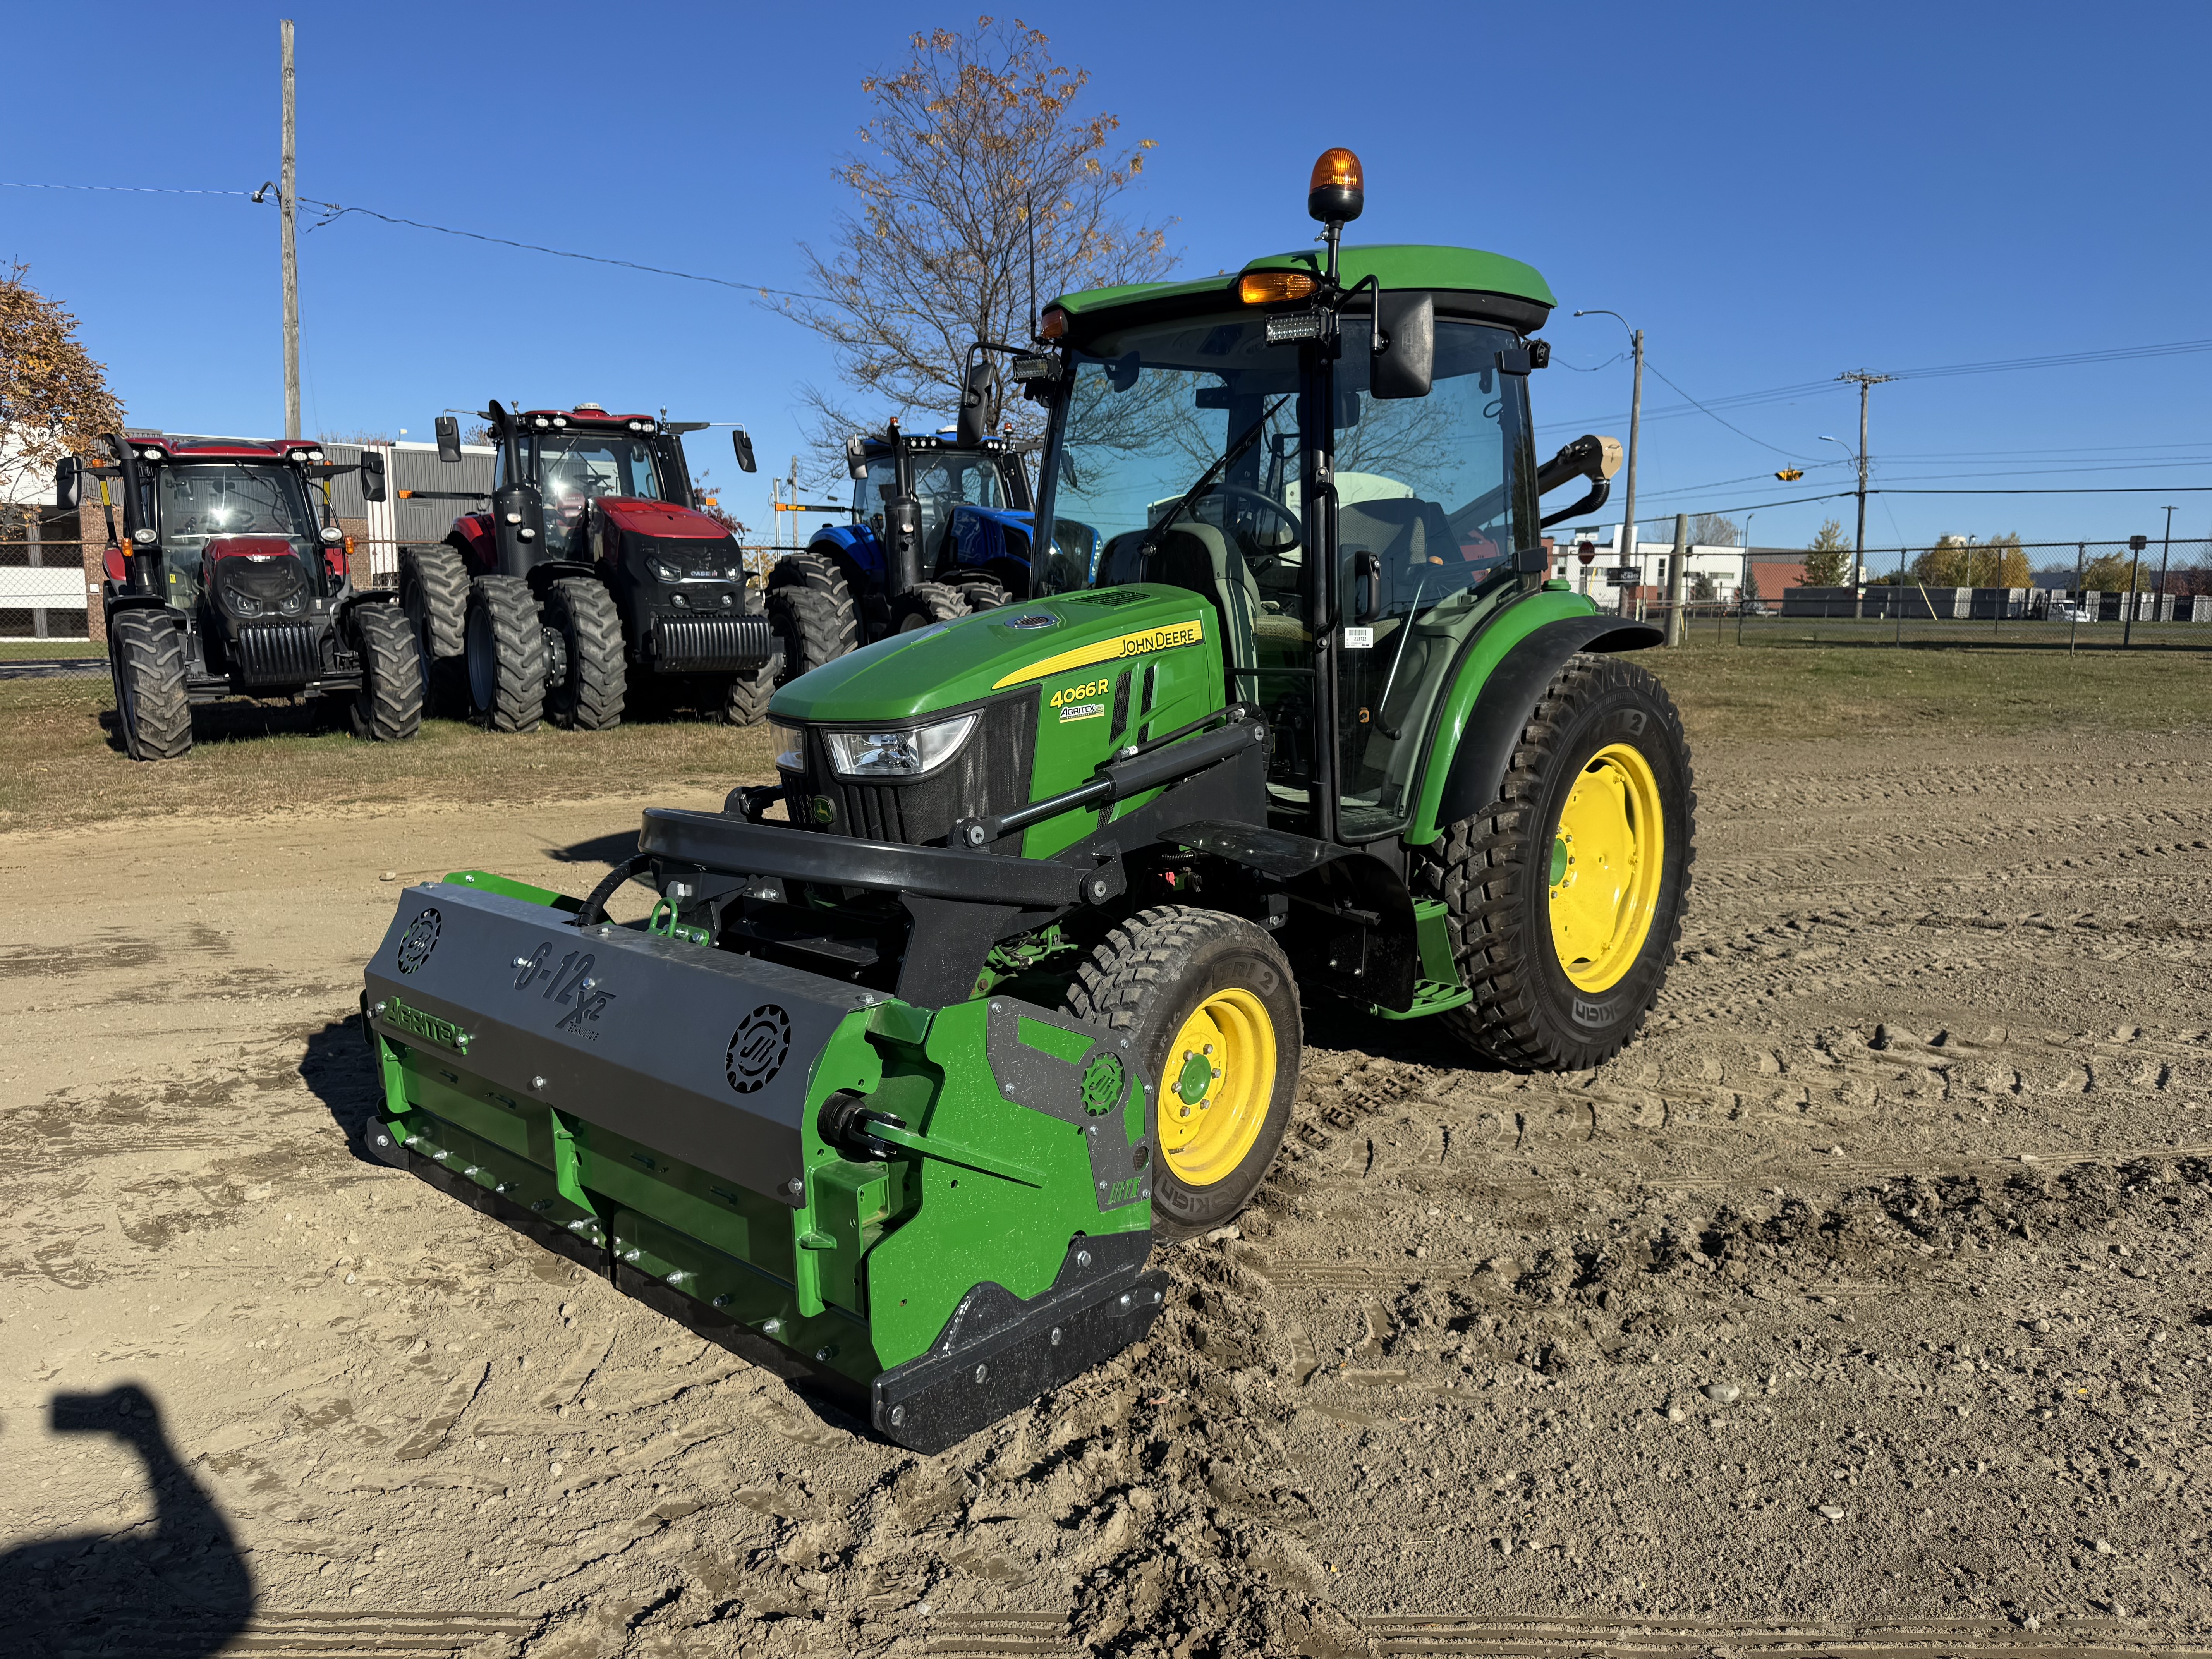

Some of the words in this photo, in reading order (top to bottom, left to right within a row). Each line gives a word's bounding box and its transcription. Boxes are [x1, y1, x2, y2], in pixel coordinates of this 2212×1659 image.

[1119, 636, 1154, 655] JOHN
[1156, 629, 1194, 647] DEERE
[1060, 705, 1095, 716] AGRITEX
[1219, 962, 1256, 981] TRI
[1259, 971, 1273, 991] 2
